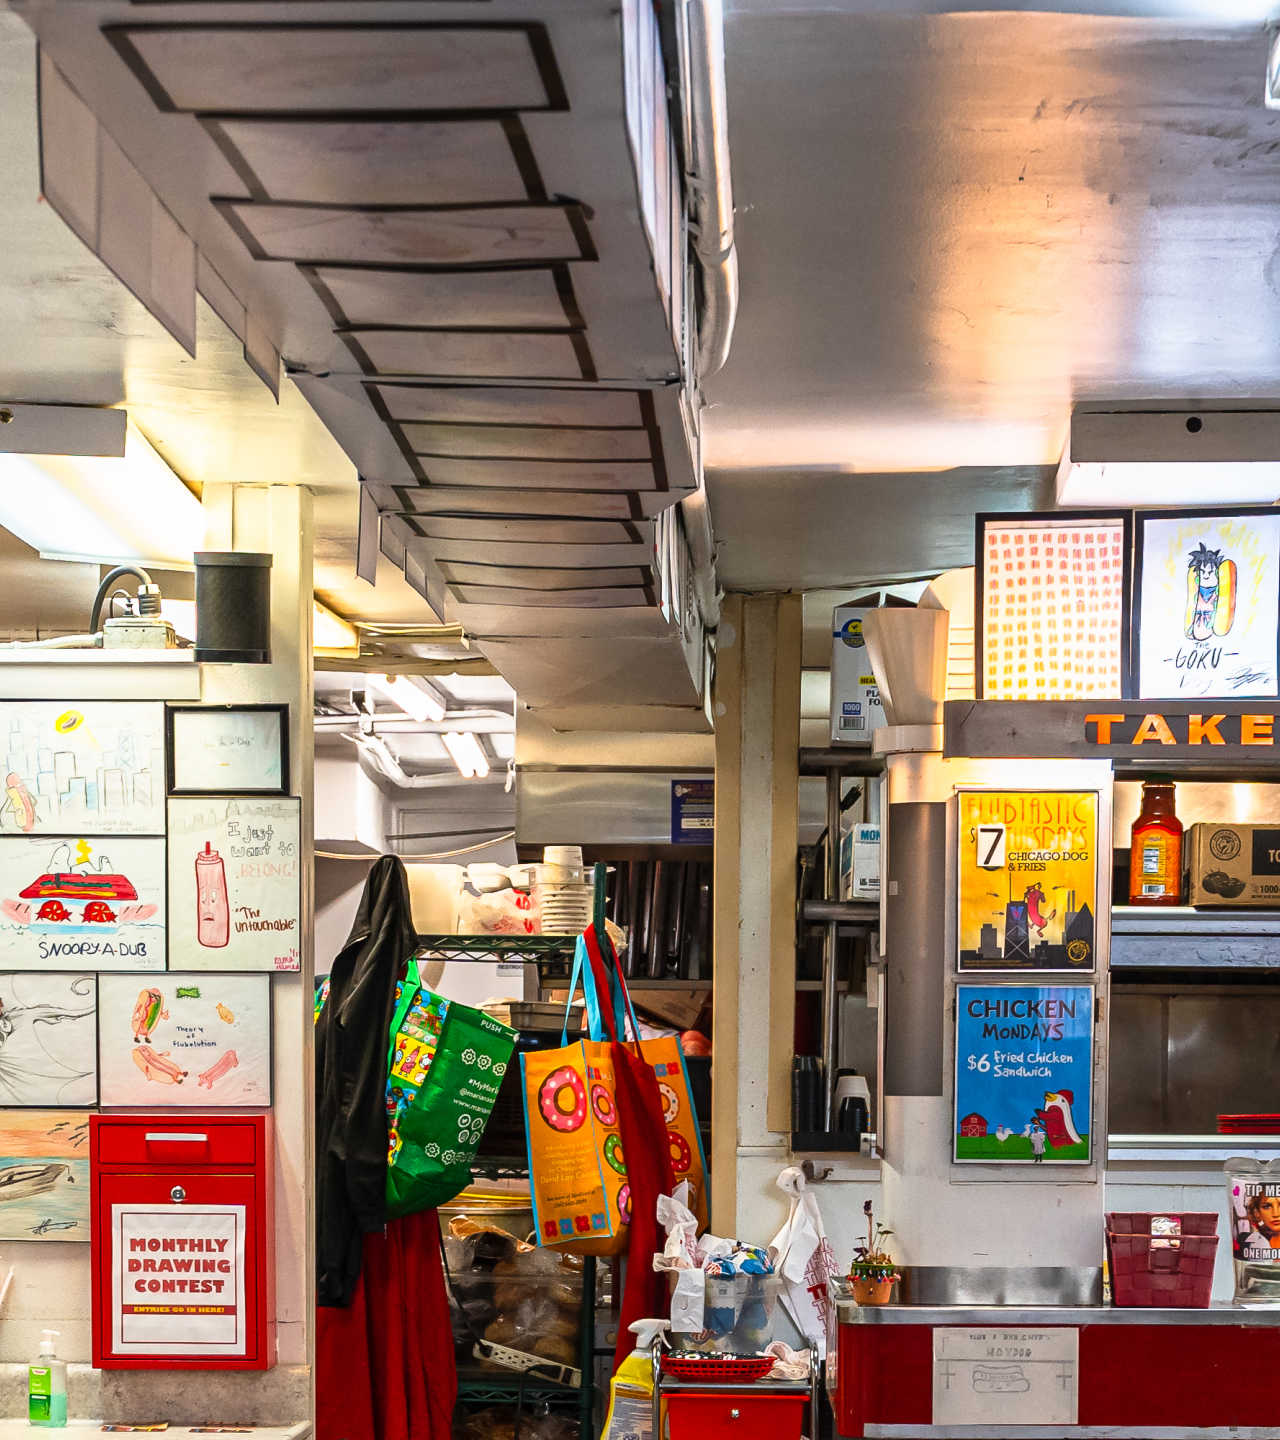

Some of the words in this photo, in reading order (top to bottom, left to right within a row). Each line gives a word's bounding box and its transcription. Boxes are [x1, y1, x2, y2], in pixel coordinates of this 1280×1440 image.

[1085, 714, 1274, 746] TAKE
[967, 797, 1087, 825] FLUBTASTIC
[1008, 852, 1060, 861] CHICAGO
[1062, 852, 1088, 861] DOG
[1008, 862, 1016, 871] &
[1017, 862, 1046, 871] FRIES
[968, 999, 1076, 1019] CHICKEN
[480, 1018, 503, 1034] PUSH
[982, 1023, 1065, 1041] MONDAYS
[967, 1053, 990, 1073] $6
[993, 1050, 1024, 1064] Fried
[1027, 1051, 1073, 1065] Chicken
[993, 1065, 1052, 1079] Sandwich
[1245, 1184, 1263, 1197] TIP
[130, 1238, 229, 1252] MONTHLY
[1243, 1247, 1261, 1258] ONE
[128, 1259, 231, 1273] DRAWING
[134, 1279, 225, 1293] CONTEST
